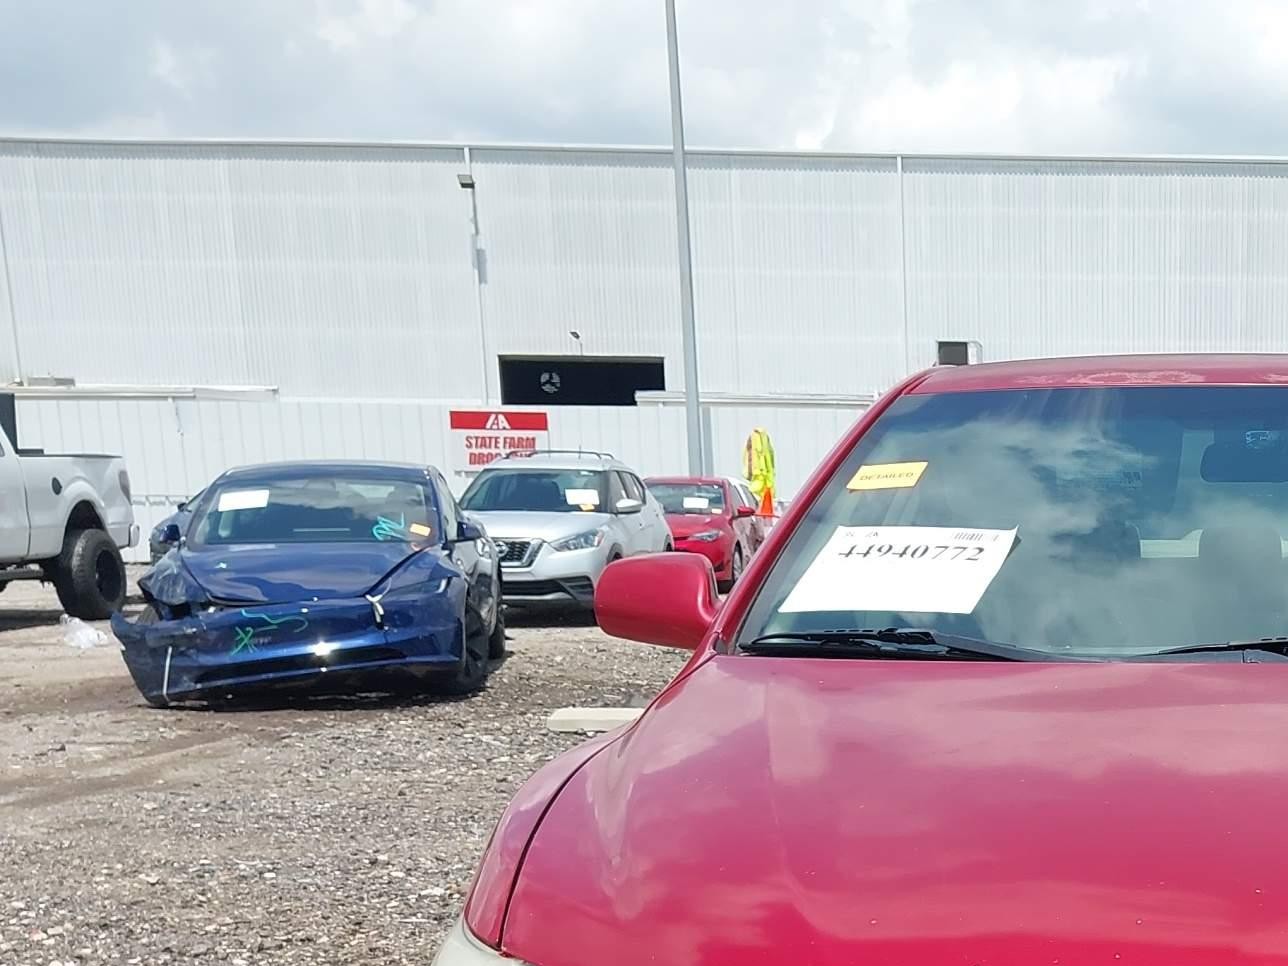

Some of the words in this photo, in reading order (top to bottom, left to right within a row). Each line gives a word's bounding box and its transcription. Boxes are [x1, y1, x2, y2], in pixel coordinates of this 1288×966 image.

[465, 435, 501, 449] STATE
[503, 436, 537, 449] FARM
[838, 544, 985, 561] 44940772
